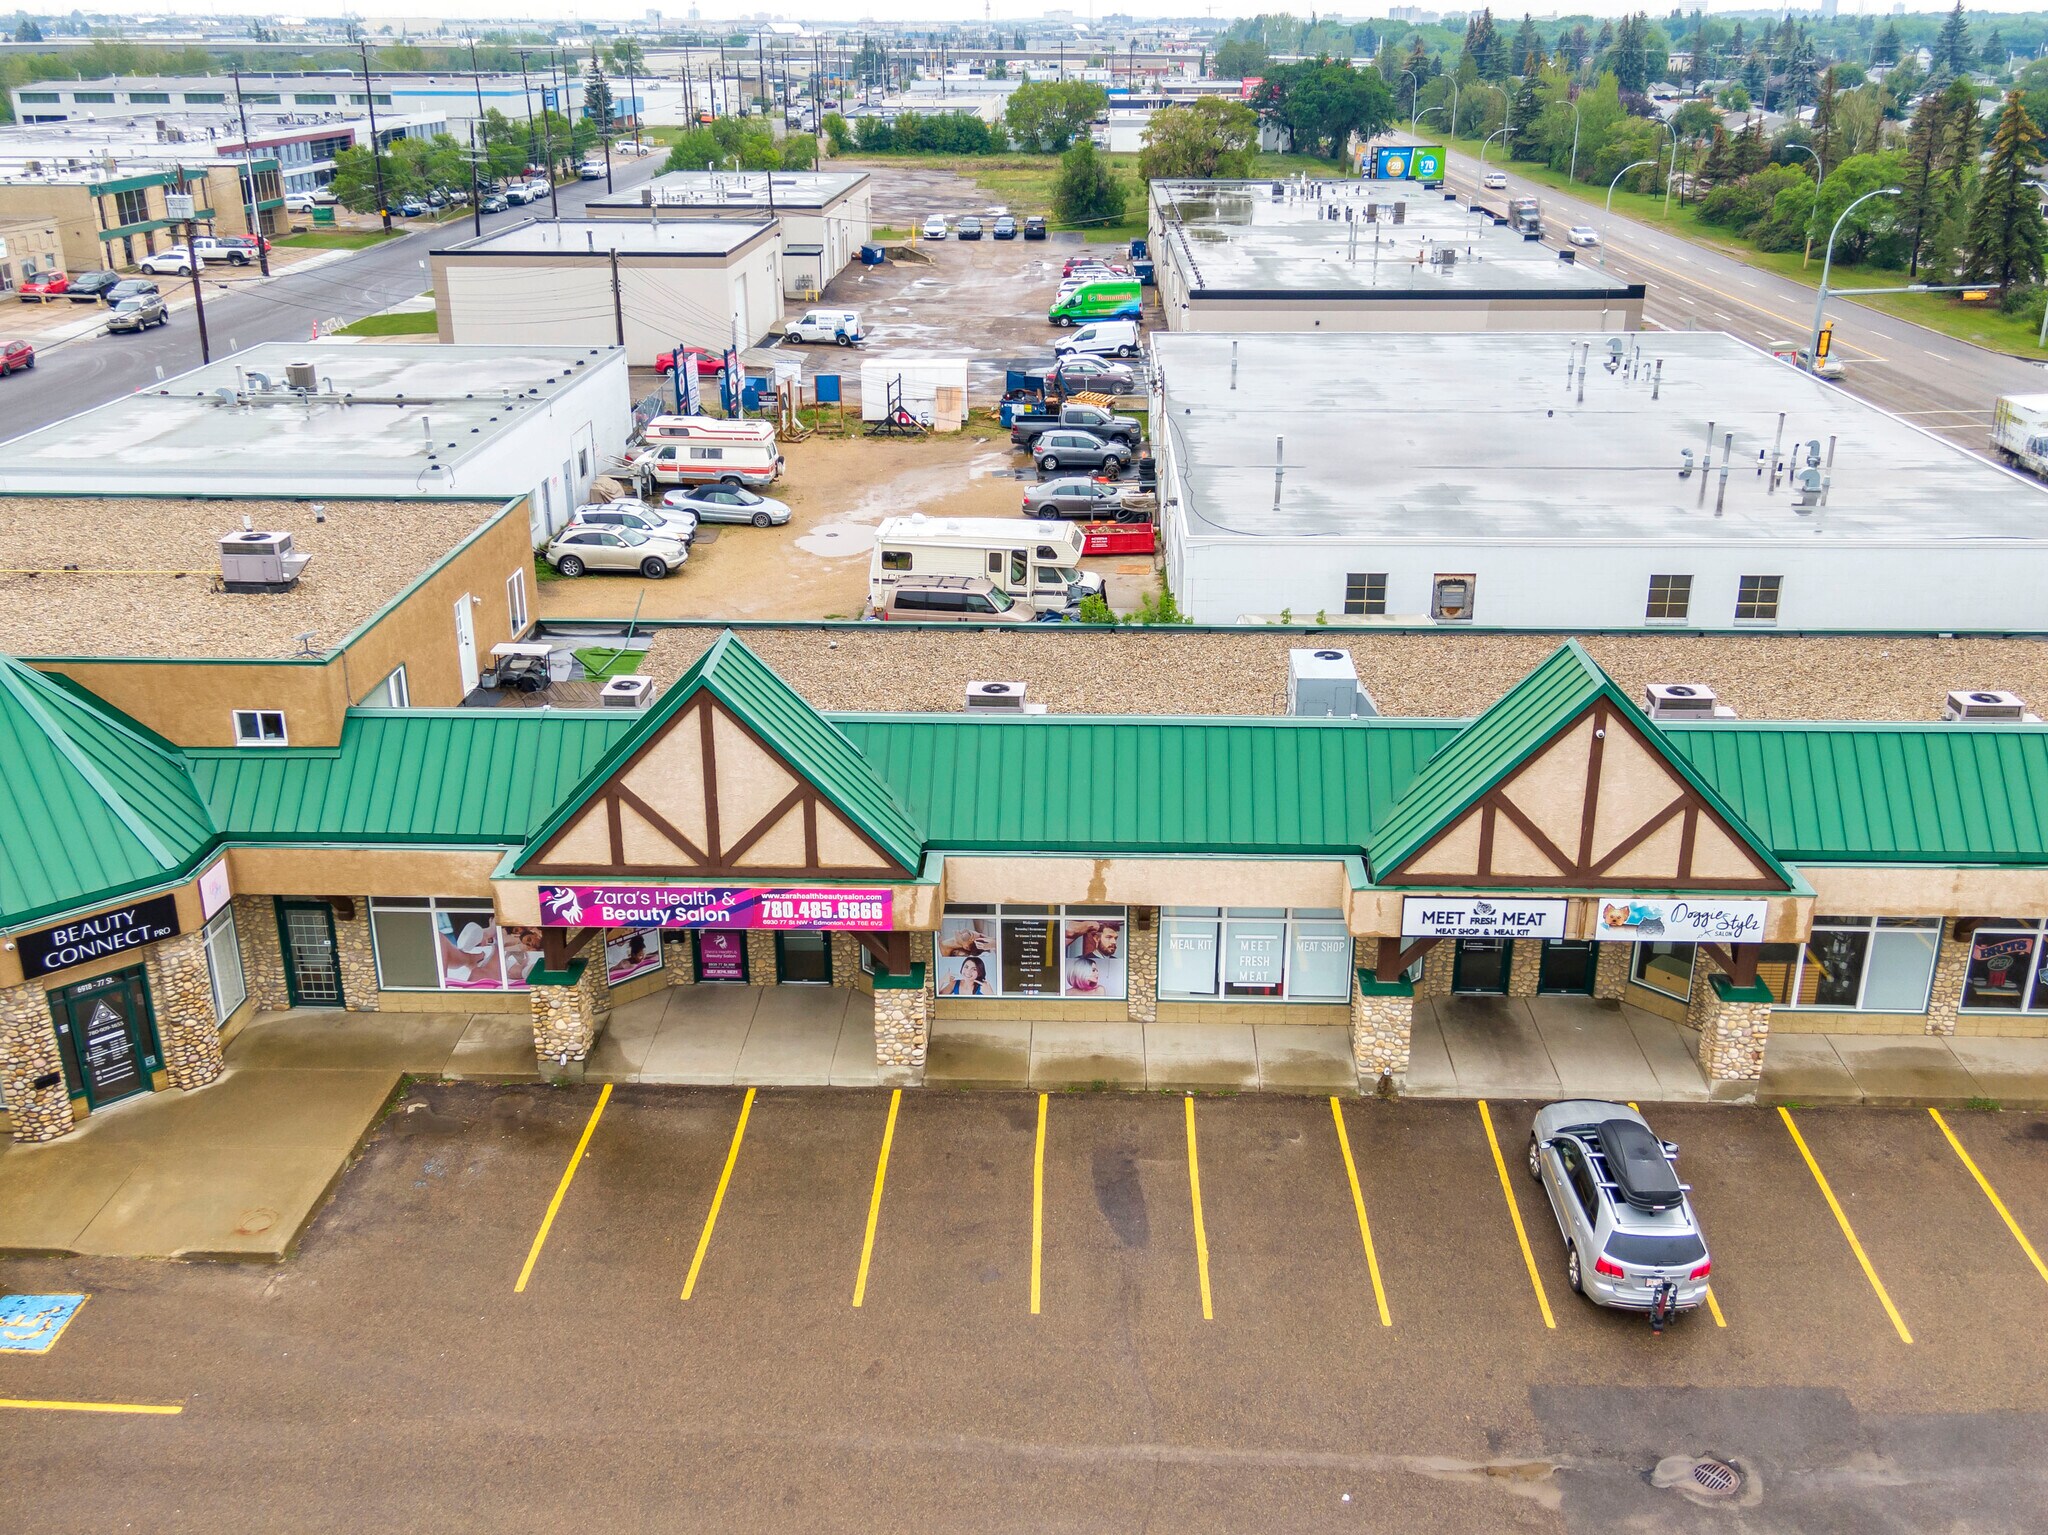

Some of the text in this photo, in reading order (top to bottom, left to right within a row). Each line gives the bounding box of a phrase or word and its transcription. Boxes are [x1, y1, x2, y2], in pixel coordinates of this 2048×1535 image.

[593, 890, 736, 906] Zara's Health &
[761, 893, 882, 901] www.zarahealthbeautysalon.com
[602, 906, 730, 925] Beauty Salon
[761, 901, 883, 919] 780.485.6866
[1671, 903, 1723, 928] Doggie
[1422, 911, 1547, 926] MEET FRESH MEAT
[53, 910, 135, 946] BEAUTY
[45, 925, 171, 968] CONNECT PRO
[1170, 939, 1213, 950] MEAL KIT
[1240, 940, 1271, 951] MEET
[1296, 941, 1345, 952] MEAT SHOP
[1239, 956, 1270, 966] FRESH
[1239, 971, 1268, 981] MEAT
[96, 979, 104, 987] 77
